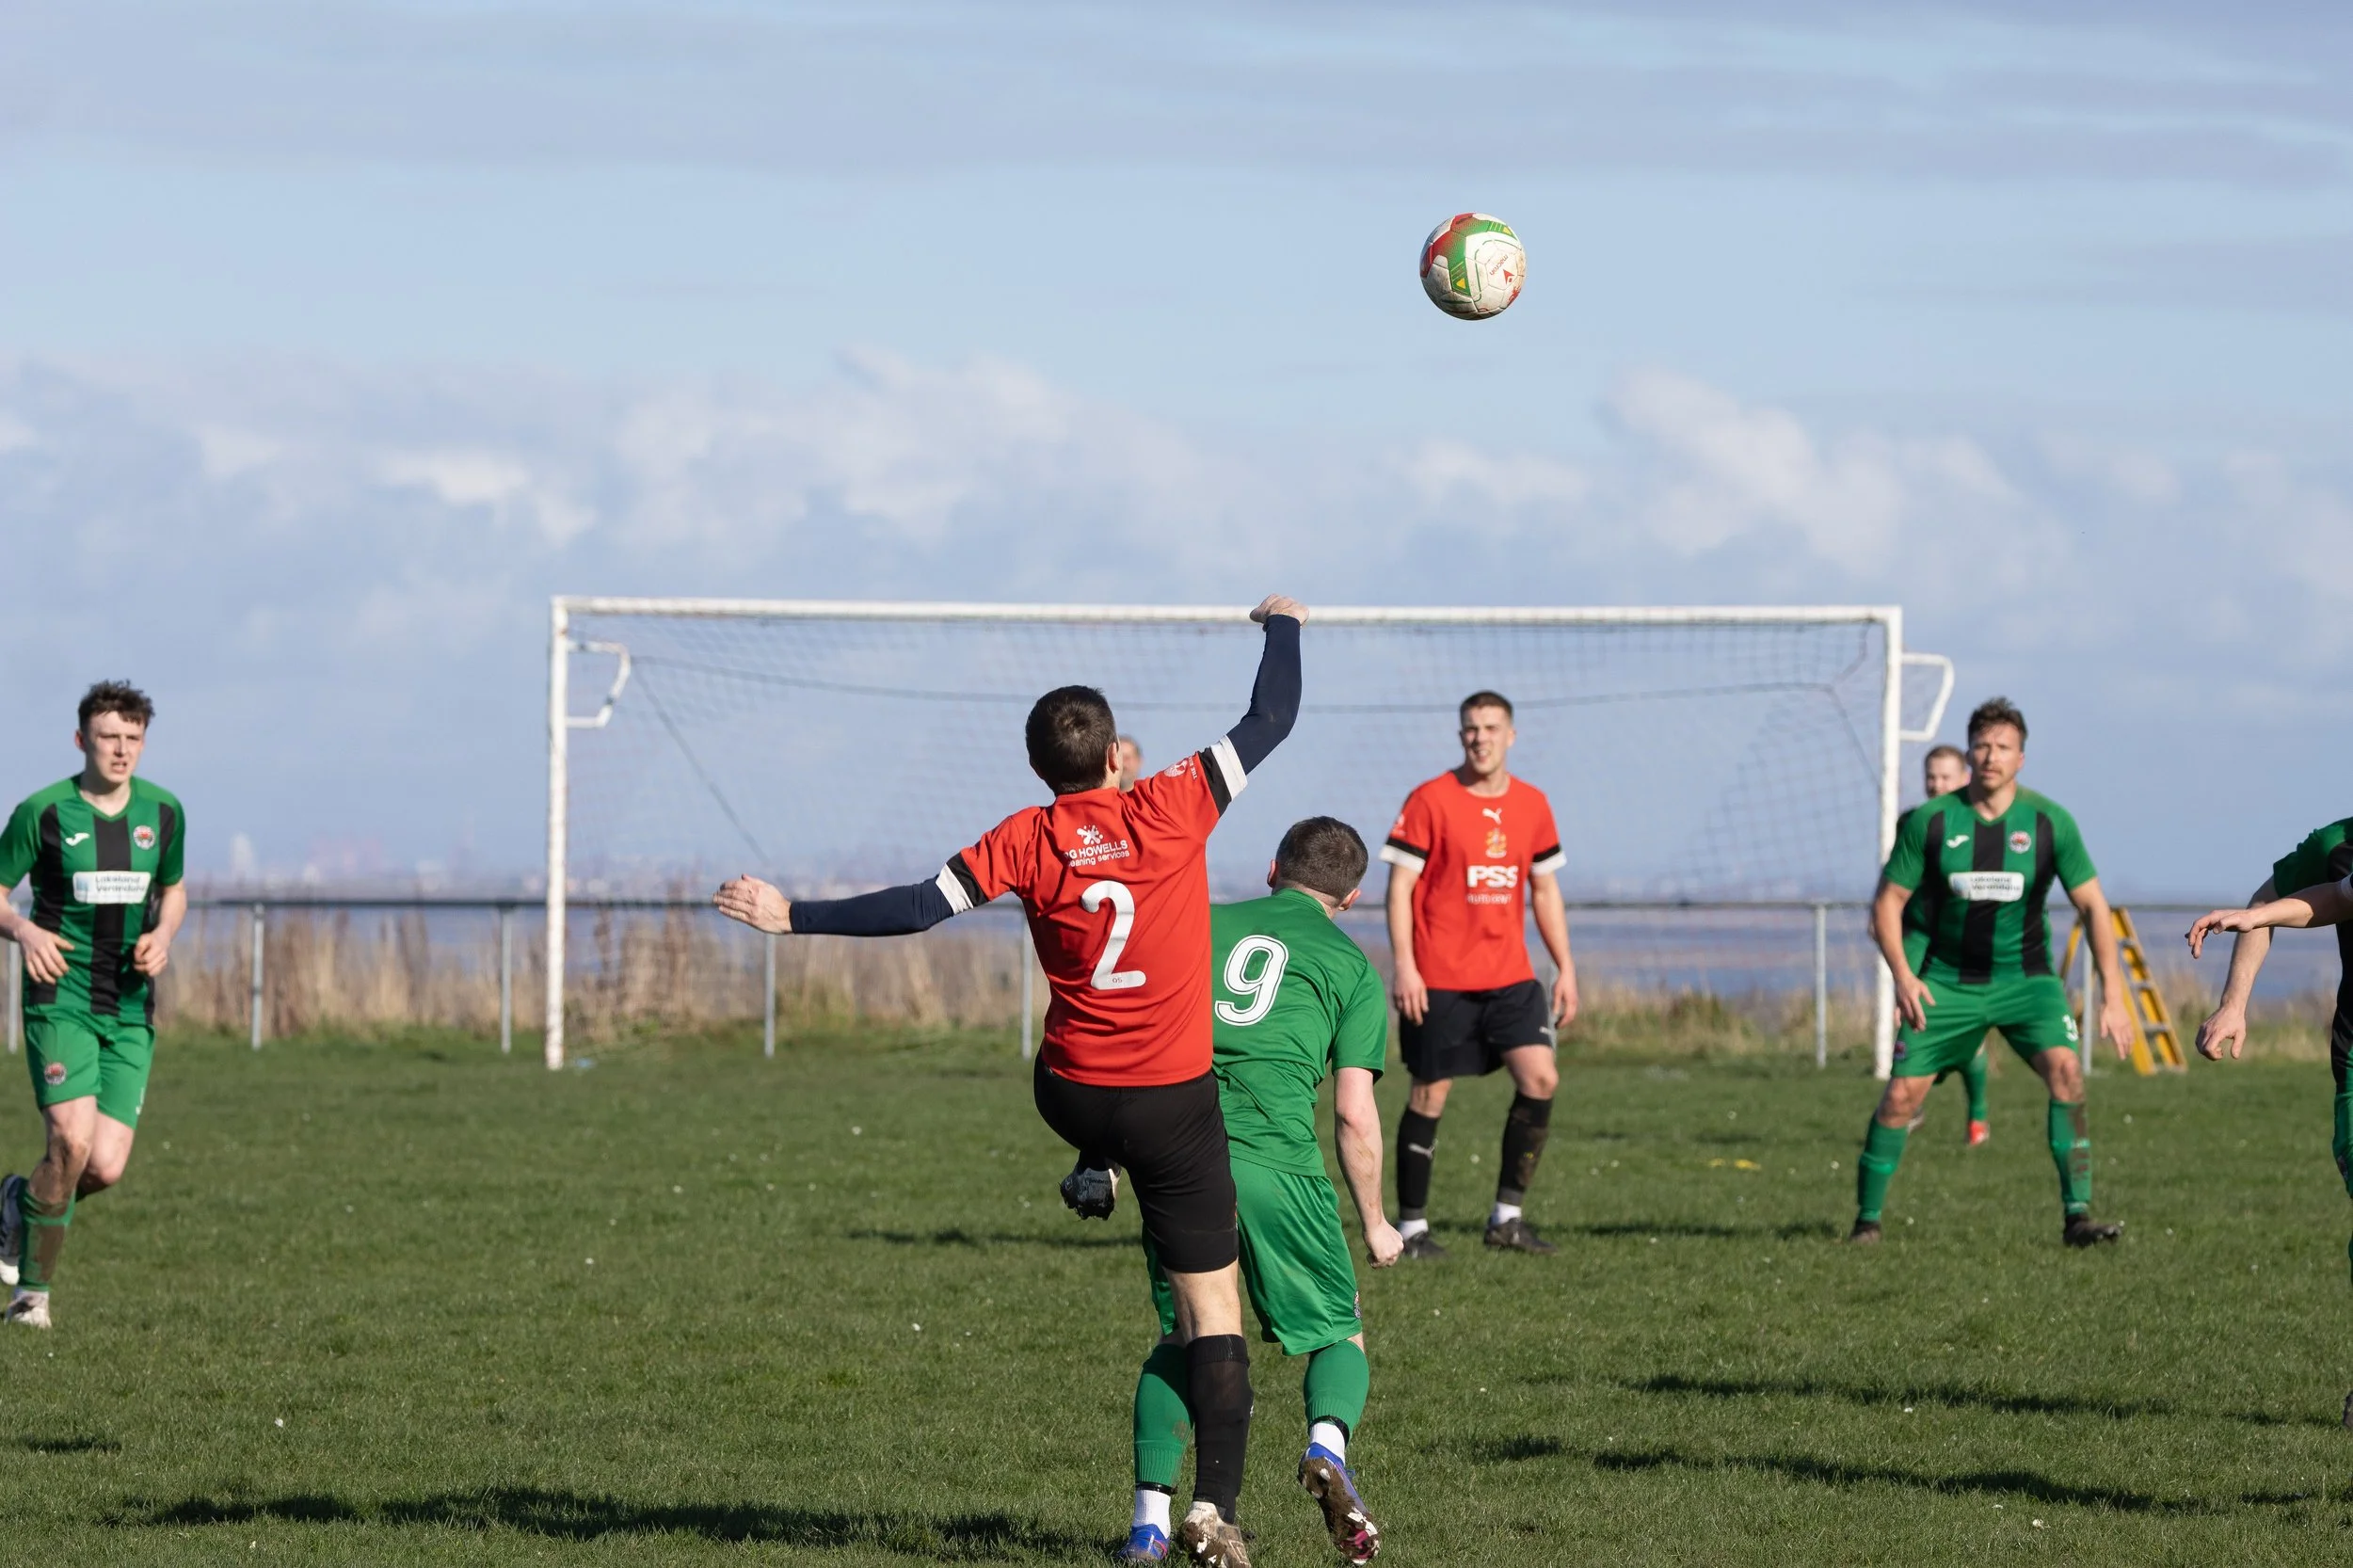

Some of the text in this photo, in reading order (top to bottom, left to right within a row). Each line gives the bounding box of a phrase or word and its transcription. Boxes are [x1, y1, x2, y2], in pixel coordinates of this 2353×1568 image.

[1489, 254, 1508, 276] macron
[1064, 840, 1128, 859] G HOWELLS
[1069, 850, 1130, 868] eaning services
[1081, 880, 1146, 990] 2
[1214, 935, 1289, 1027] 9
